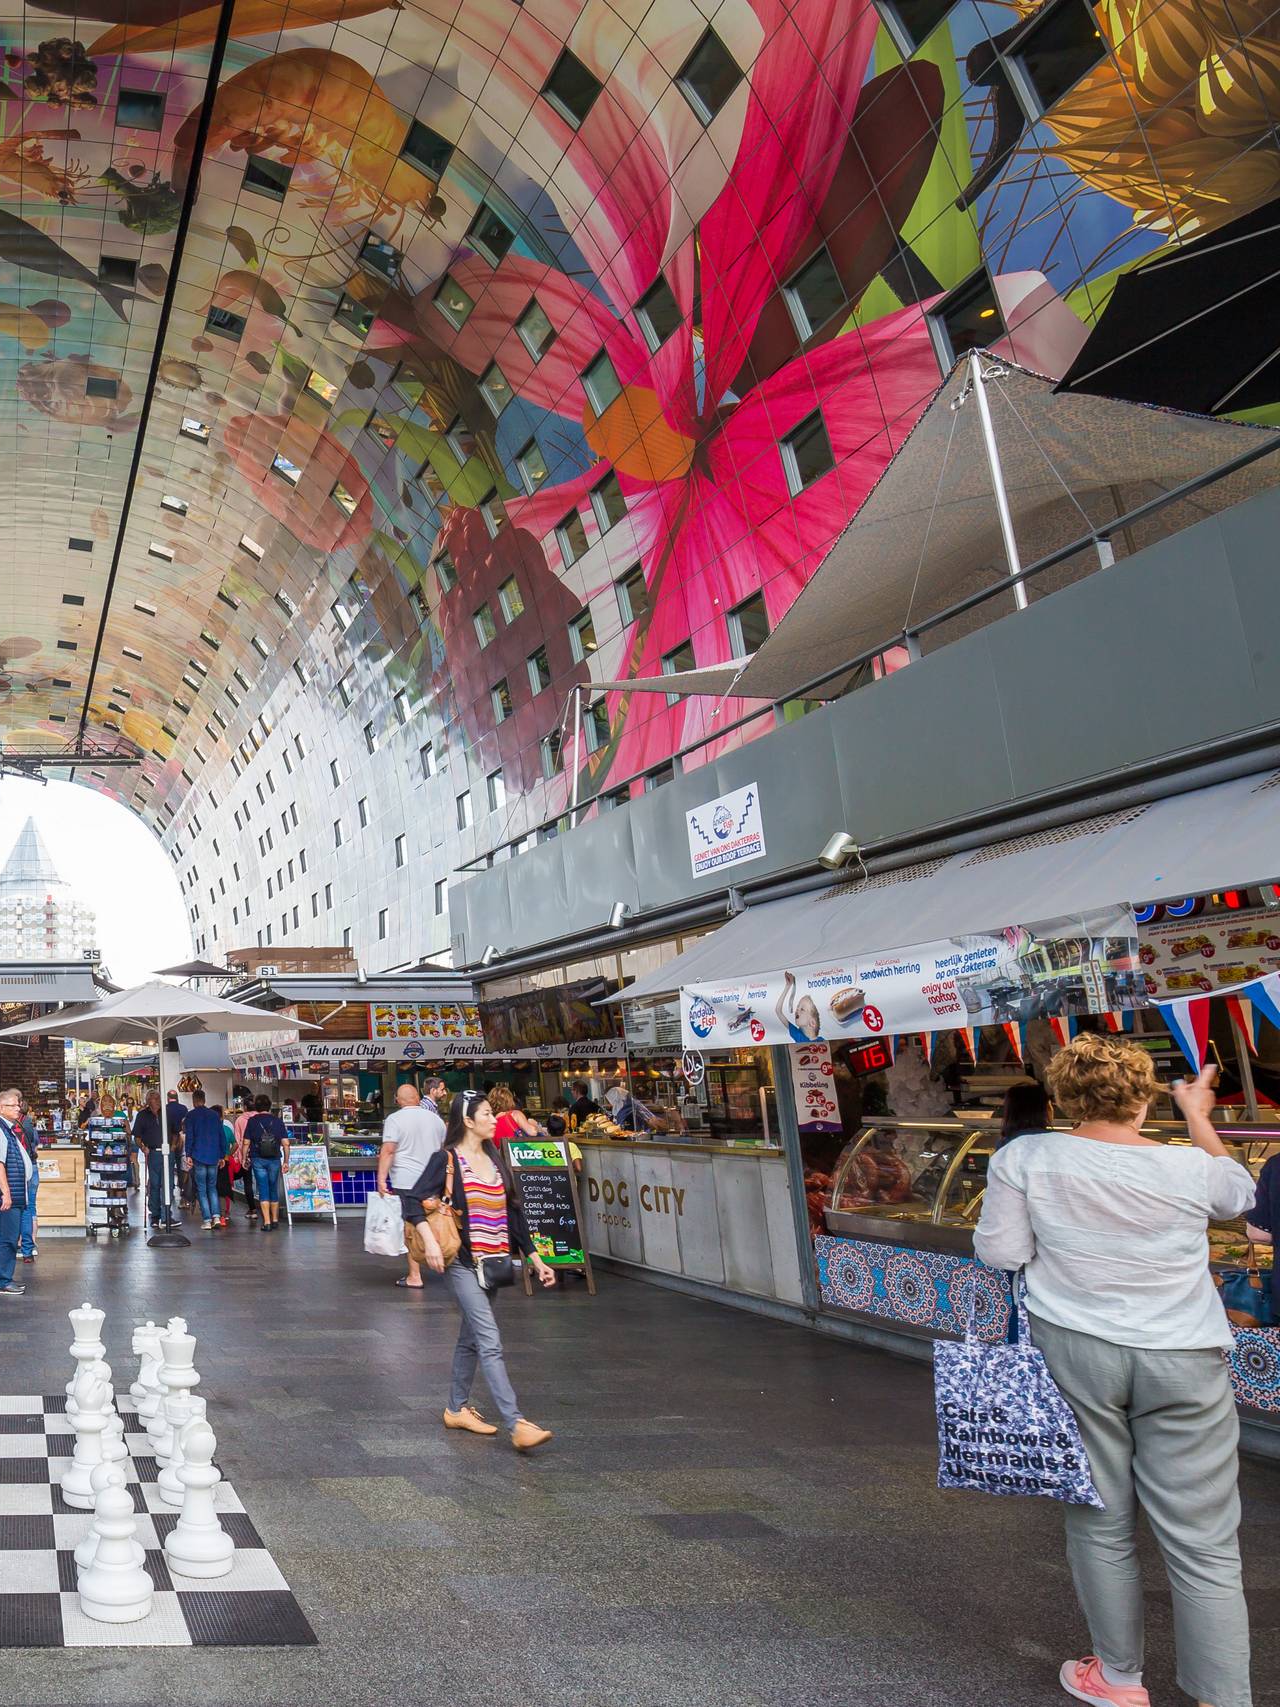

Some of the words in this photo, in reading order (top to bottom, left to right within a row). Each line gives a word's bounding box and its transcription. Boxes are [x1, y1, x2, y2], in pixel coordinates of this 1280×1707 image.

[696, 861, 711, 871] ENJOY
[711, 856, 722, 866] OUR
[723, 852, 736, 862] ROOF
[737, 842, 761, 857] TERRACE
[83, 950, 100, 959] 39
[935, 954, 962, 969] heerlijk
[964, 946, 997, 962] genieten
[261, 967, 276, 976] 61
[860, 967, 892, 980] sandwich
[893, 962, 920, 974] herring
[935, 971, 945, 980] op
[946, 968, 960, 977] ons
[960, 958, 996, 974] dakterras
[807, 976, 831, 988] broodje
[831, 974, 853, 985] haring
[921, 982, 941, 994] enjoy
[942, 979, 955, 989] our
[723, 992, 740, 1002] haring
[747, 989, 767, 999] herring
[928, 991, 957, 1004] rooftop
[688, 1004, 715, 1020] Andalus
[934, 1002, 961, 1016] terrace
[701, 1015, 717, 1028] Fish
[307, 1044, 331, 1056] Fish
[332, 1044, 355, 1056] and
[356, 1043, 386, 1058] Chips
[443, 1043, 492, 1055] Arachi
[567, 1042, 606, 1056] Gezond
[607, 1042, 618, 1053] &
[863, 1045, 885, 1069] 16
[513, 1146, 562, 1160] fuzetea
[588, 1177, 629, 1207] DOG
[640, 1184, 685, 1216] CITY
[943, 1403, 989, 1424] Cats
[992, 1407, 1009, 1424] &
[944, 1422, 1052, 1449] Rainbows
[1055, 1432, 1073, 1450] &
[945, 1442, 1059, 1471] Mermaids
[1063, 1453, 1080, 1471] &
[946, 1462, 1062, 1490] Unicorns.
